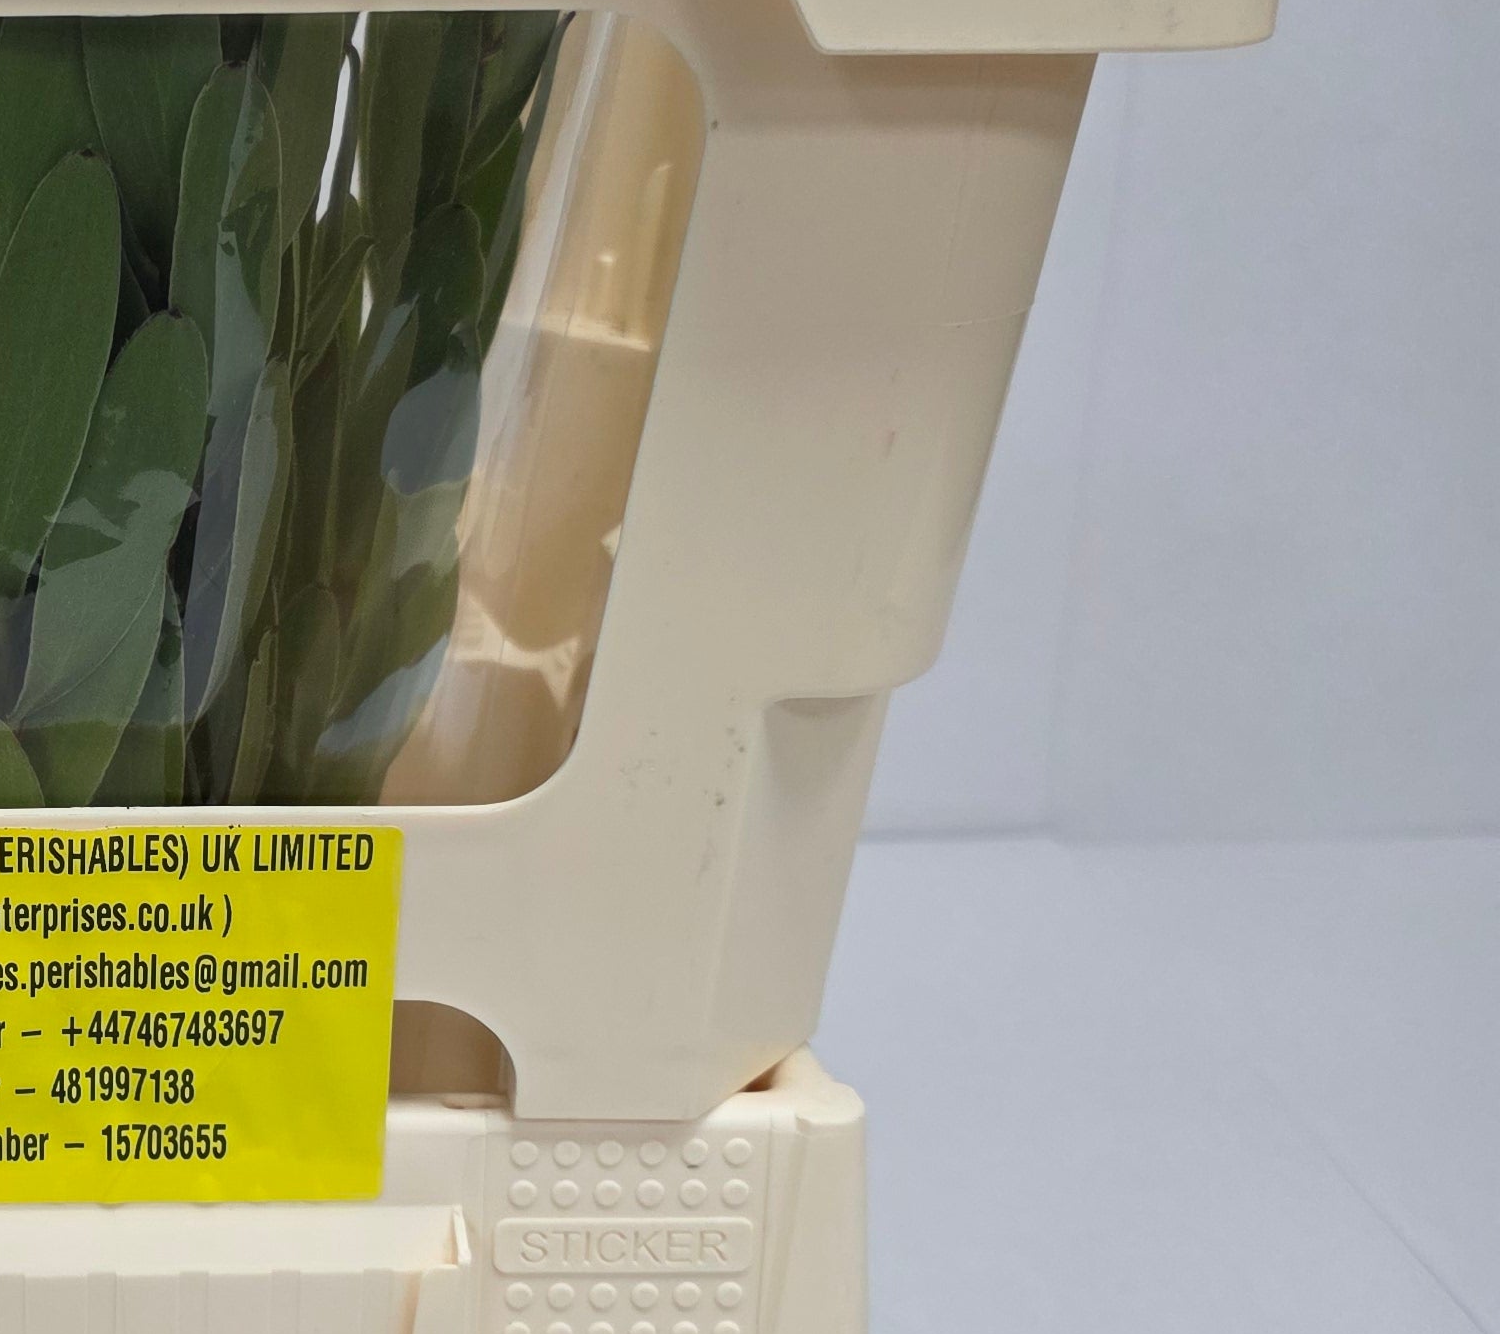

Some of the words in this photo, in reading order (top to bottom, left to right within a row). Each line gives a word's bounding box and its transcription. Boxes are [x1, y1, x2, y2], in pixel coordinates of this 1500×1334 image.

[202, 834, 242, 873] UK
[253, 833, 374, 872] LIMITED
[61, 1009, 285, 1049] +447467483697
[50, 1065, 195, 1105] 481997138
[101, 1123, 227, 1162] 15703655
[520, 1229, 728, 1264] STICKER
